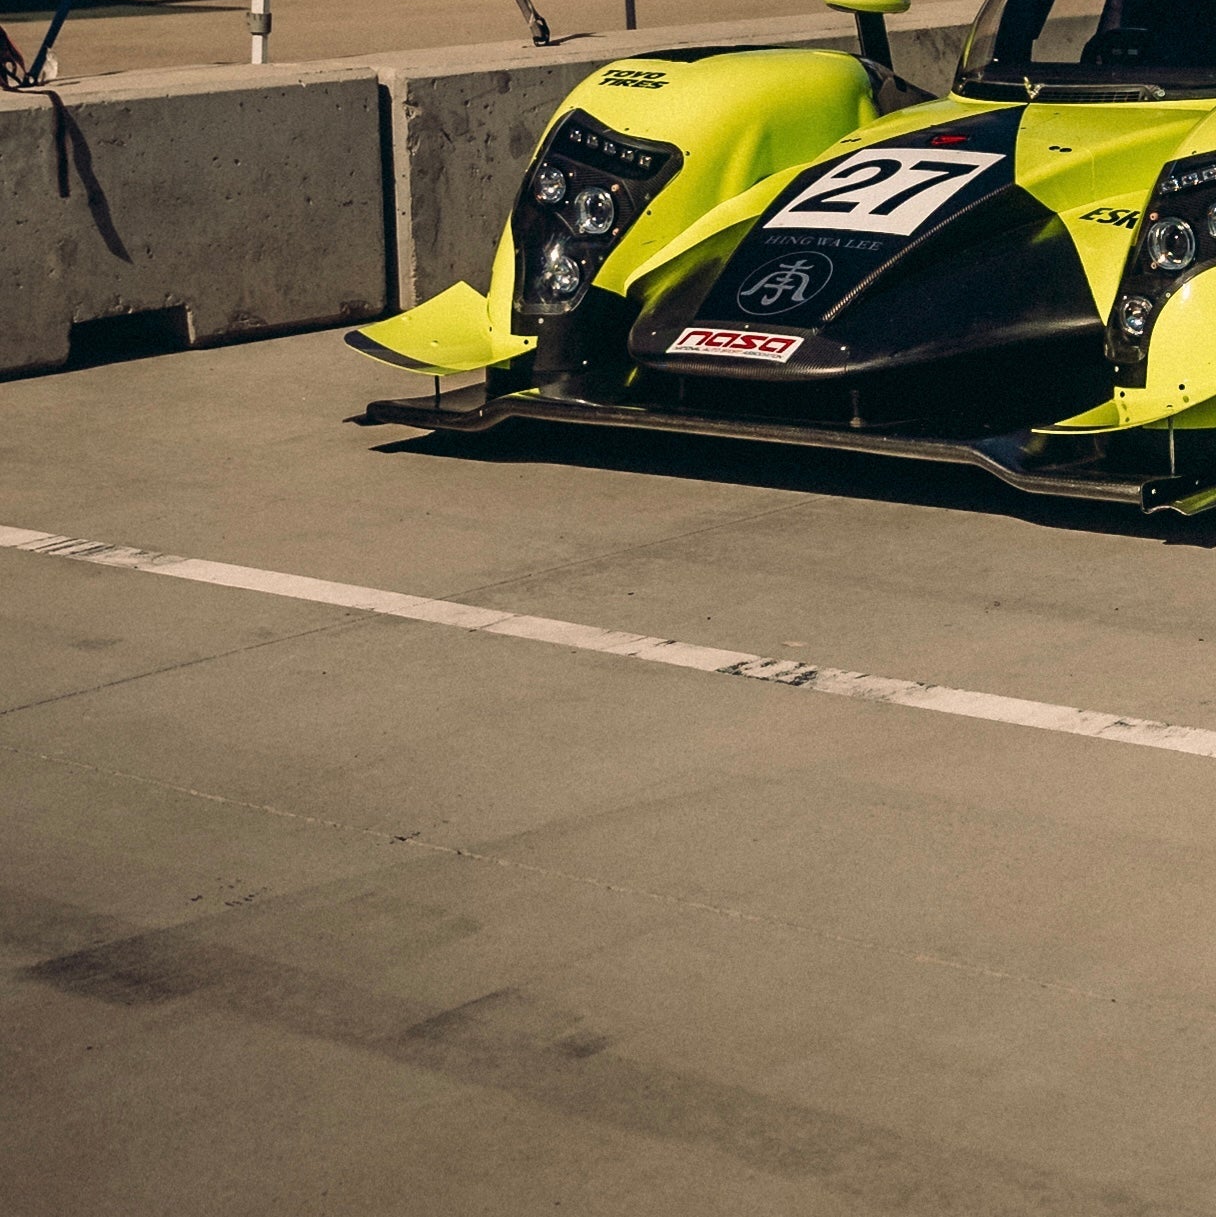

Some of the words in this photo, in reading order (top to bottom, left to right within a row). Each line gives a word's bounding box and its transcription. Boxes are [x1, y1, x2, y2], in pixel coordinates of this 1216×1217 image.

[601, 70, 666, 79] TOYO
[598, 78, 670, 89] TIRES
[788, 159, 981, 216] 27
[1079, 208, 1140, 229] ESR
[764, 236, 815, 244] HING
[817, 237, 841, 247] WA
[844, 239, 883, 251] LEE
